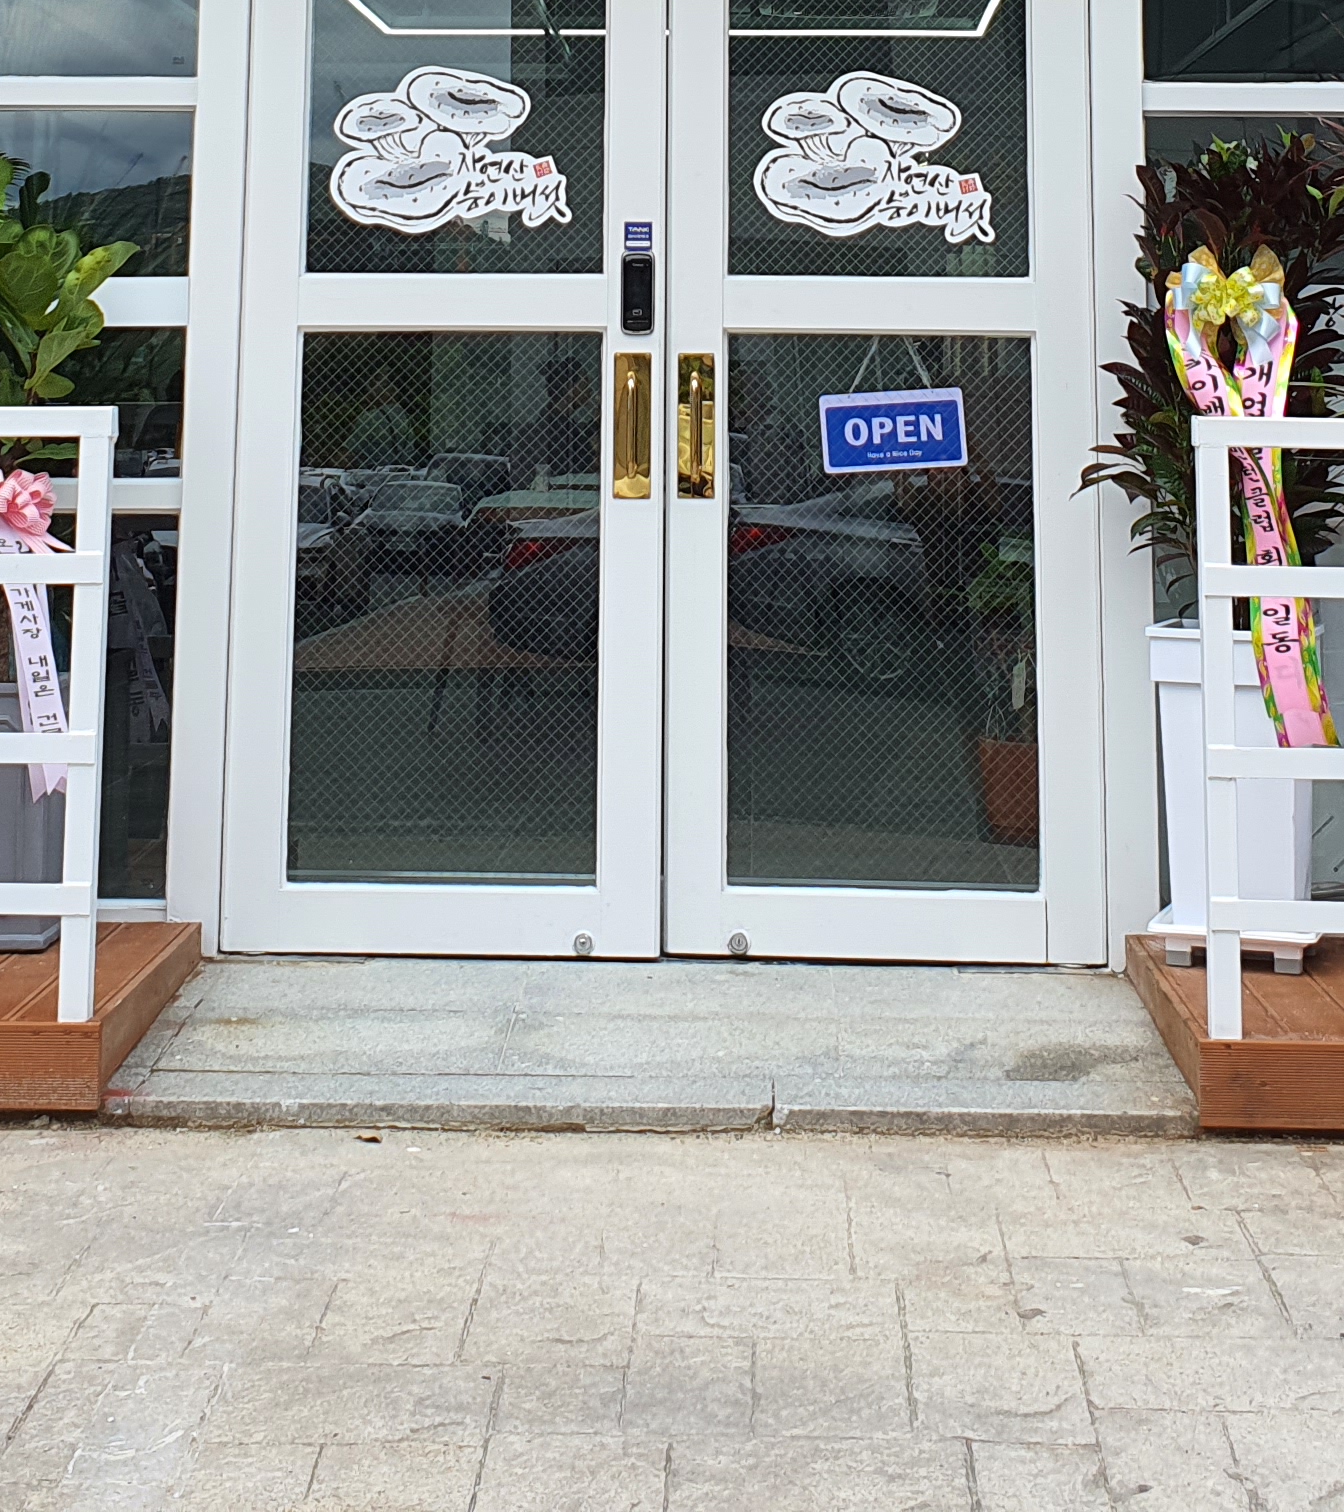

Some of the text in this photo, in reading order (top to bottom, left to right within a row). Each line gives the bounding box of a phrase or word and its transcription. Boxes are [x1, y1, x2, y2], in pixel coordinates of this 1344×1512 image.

[457, 151, 529, 183] 자연산
[881, 160, 954, 196] 자연산
[456, 179, 567, 222] 능이버섯
[878, 189, 990, 238] 능이버섯
[844, 413, 944, 447] OPEN
[867, 451, 885, 459] Have
[909, 449, 923, 458] Day
[9, 587, 43, 640] 가게사장
[28, 654, 56, 698] 내일은
[1262, 594, 1301, 653] 일동
